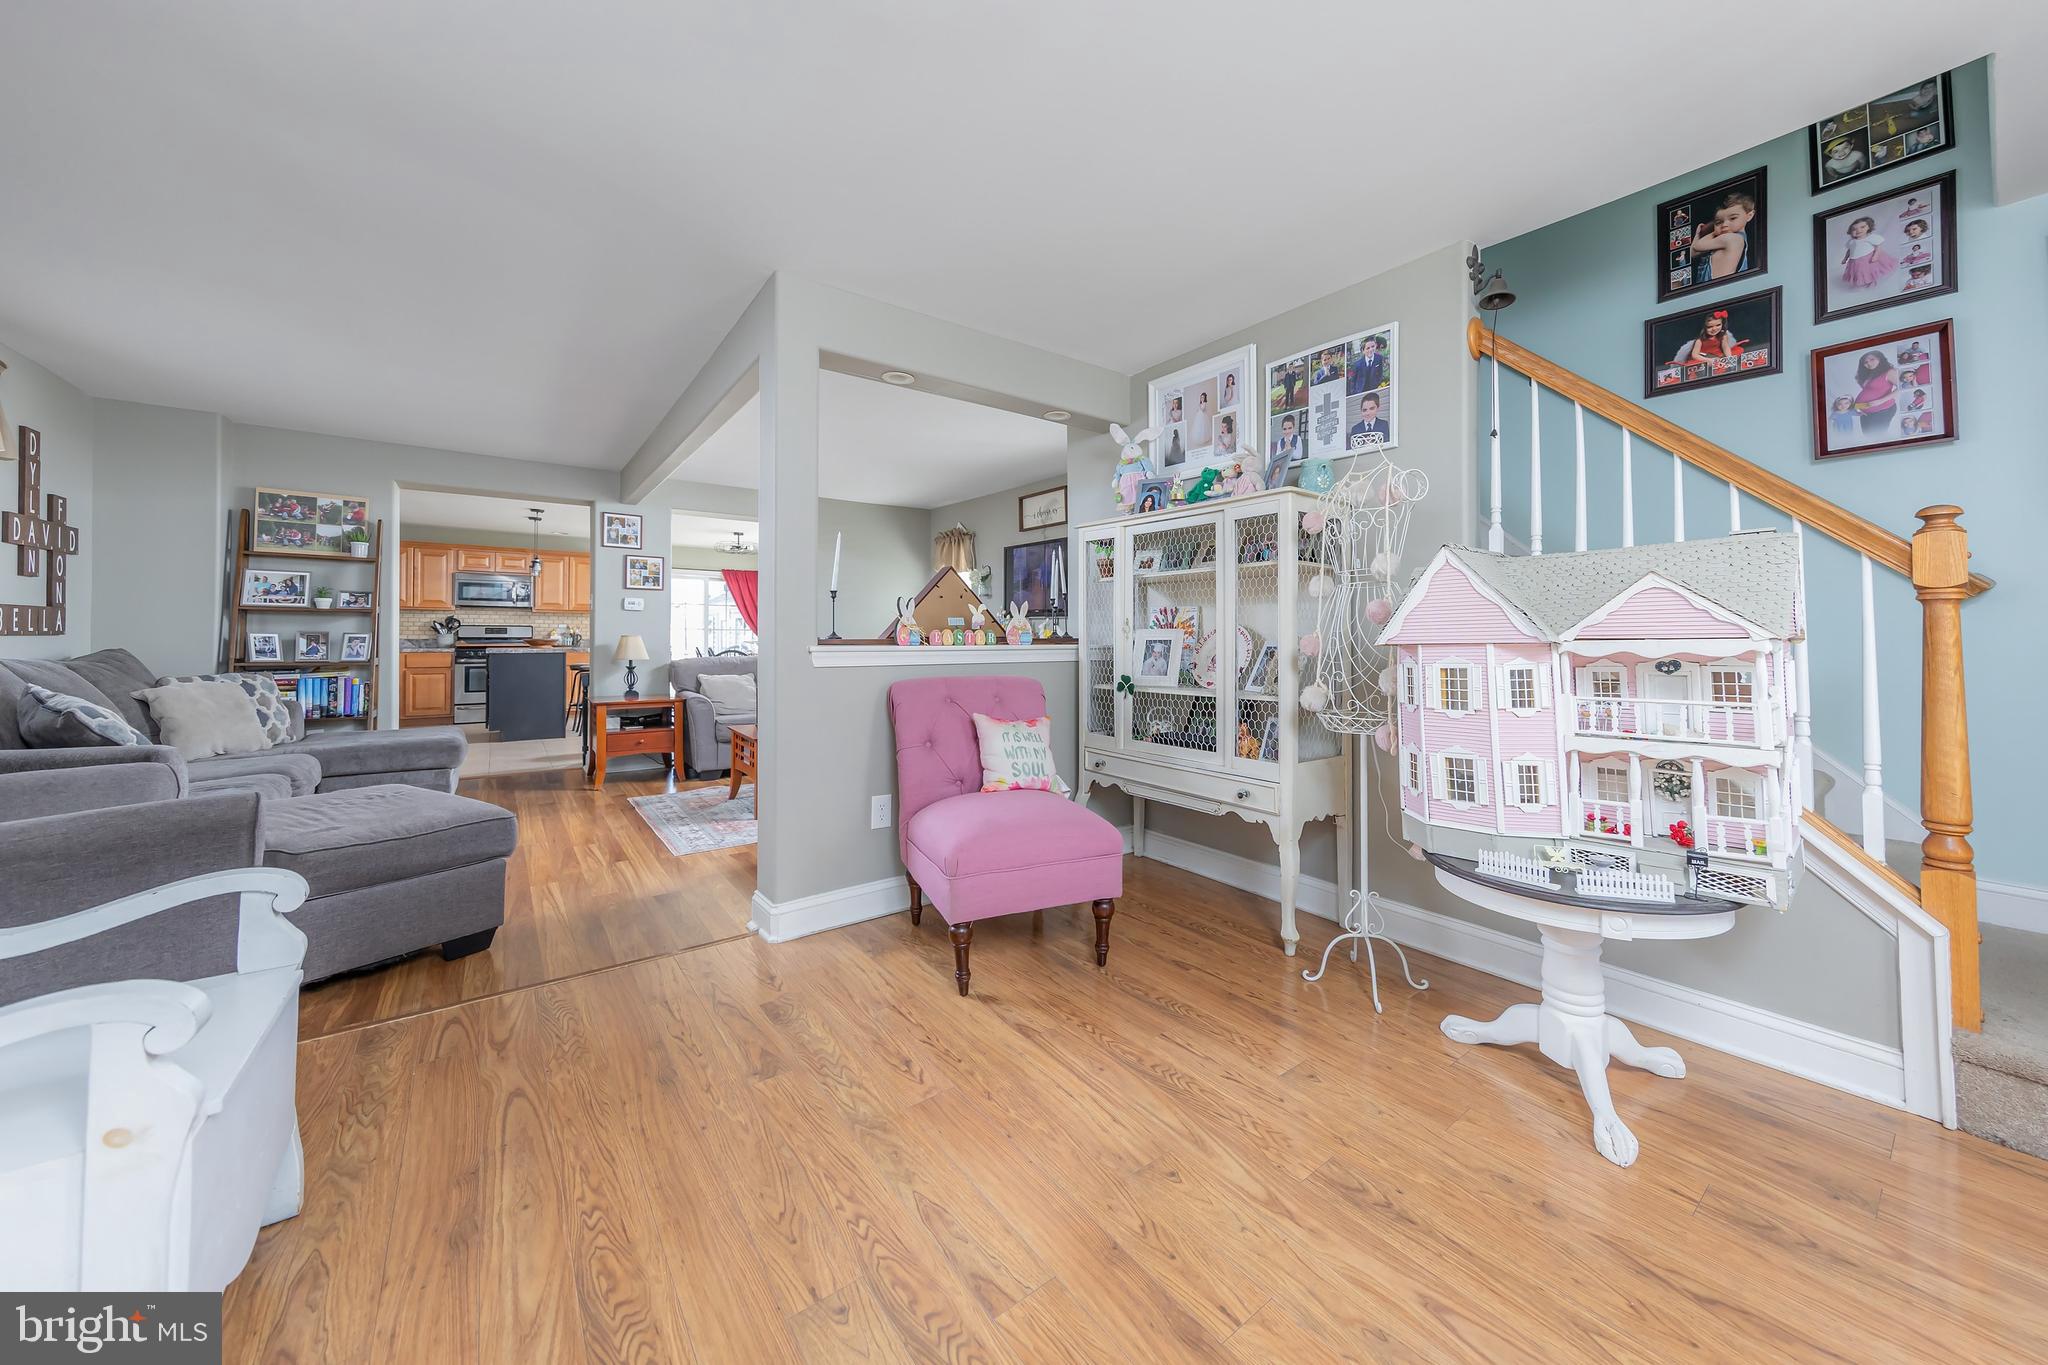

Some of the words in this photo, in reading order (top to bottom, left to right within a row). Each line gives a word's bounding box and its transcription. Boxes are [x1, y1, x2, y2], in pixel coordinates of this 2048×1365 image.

[27, 432, 37, 573] DYLAN
[13, 517, 76, 552] DAVID
[54, 499, 64, 632] FIONA
[935, 631, 994, 644] EASTER
[1022, 731, 1044, 744] WELL
[1032, 746, 1047, 761] MY
[1011, 761, 1047, 778] SOUL
